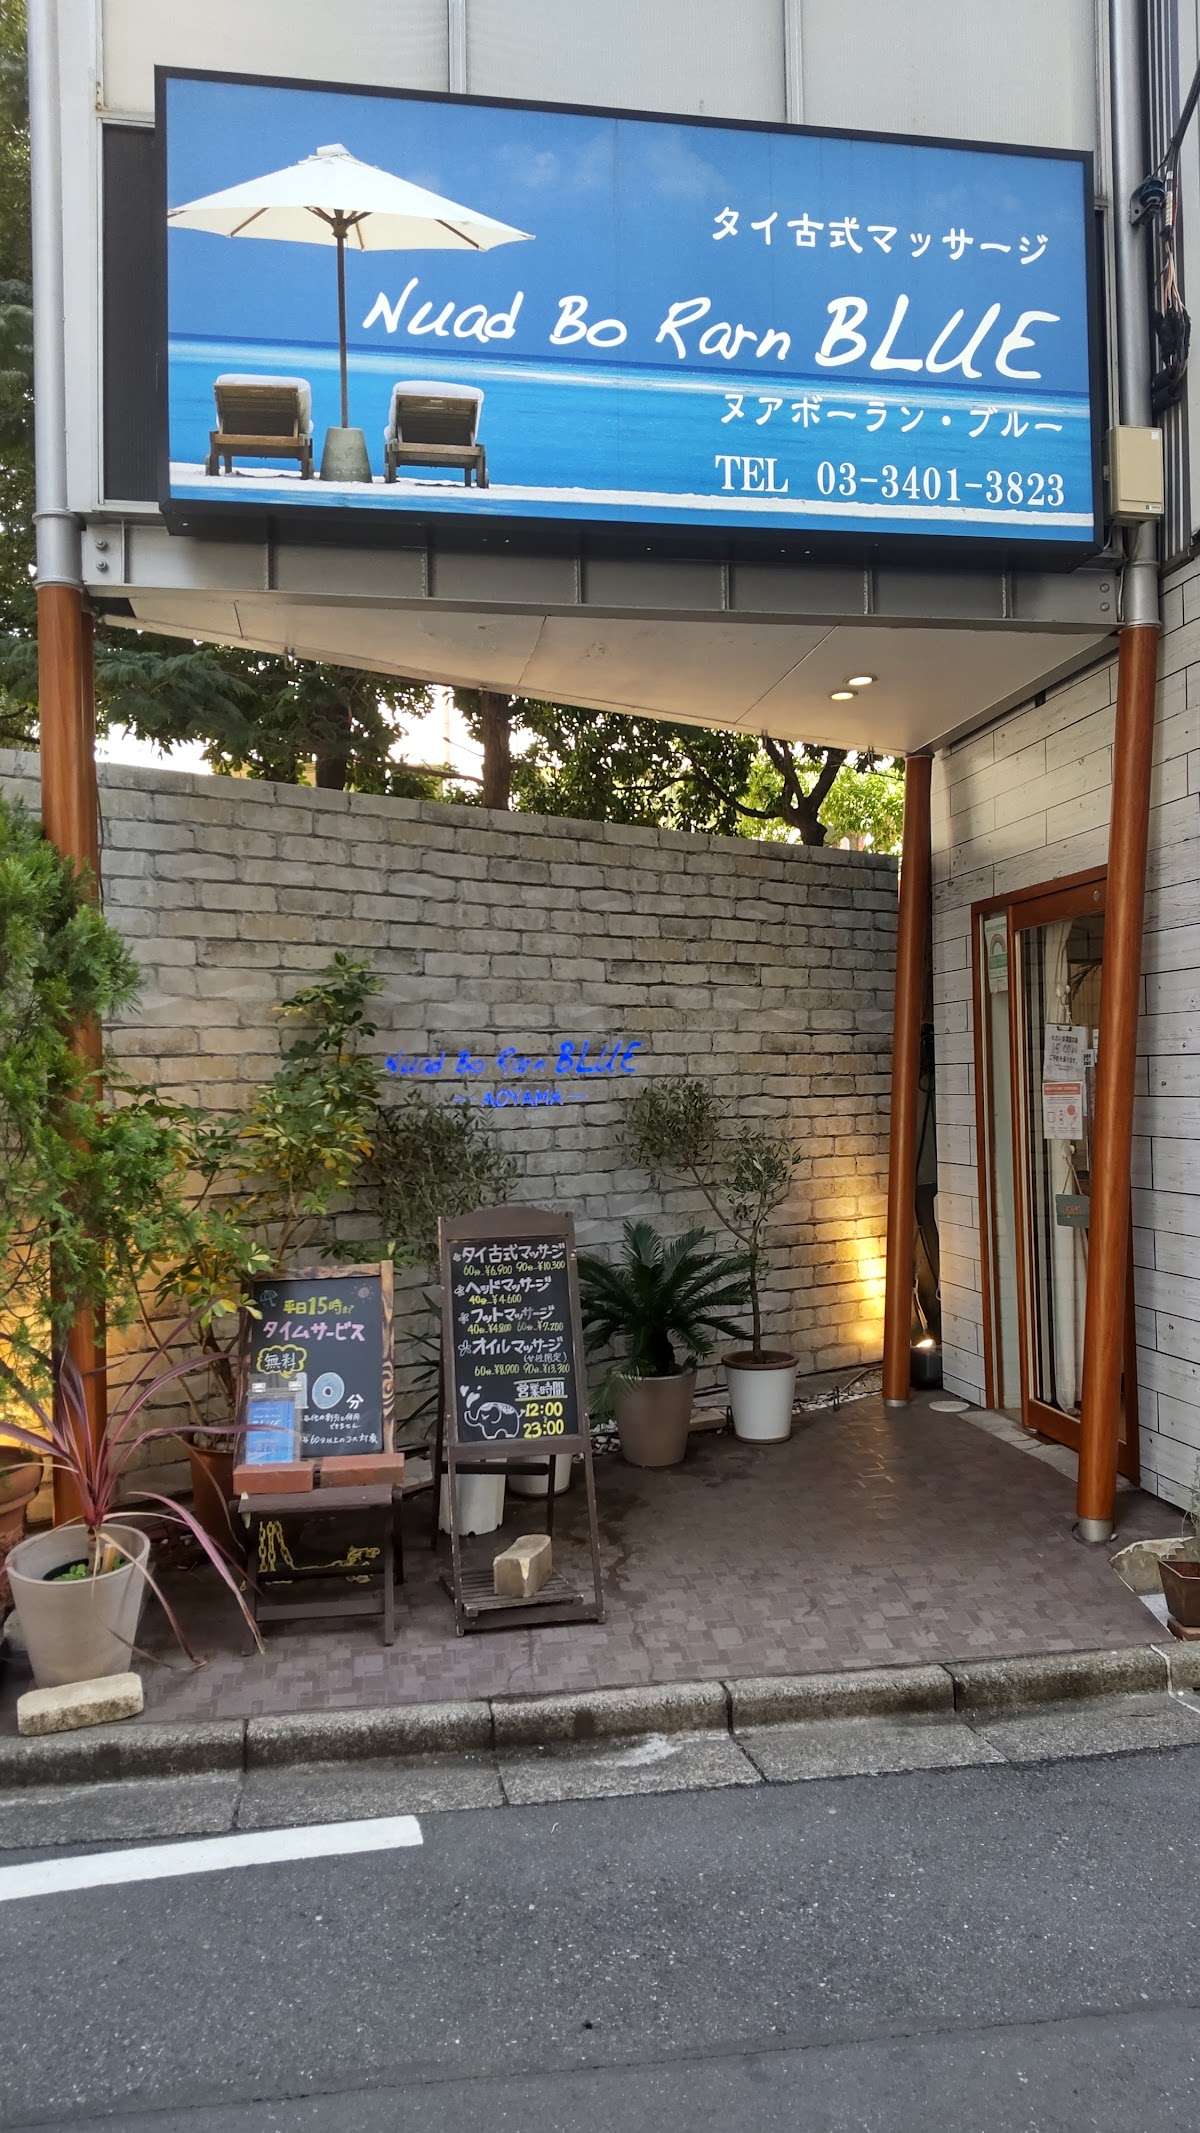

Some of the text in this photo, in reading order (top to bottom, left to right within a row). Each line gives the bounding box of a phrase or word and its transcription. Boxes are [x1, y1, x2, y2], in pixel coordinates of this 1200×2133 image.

[712, 206, 1049, 265] タイ古式マッサージ
[362, 277, 1061, 379] Nuad Bo Rarn BLUE
[720, 393, 1063, 438] ヌアボーラン・ブルー
[715, 455, 1065, 507] TEL 03-3401-3823
[456, 1050, 486, 1075] Bo
[555, 1040, 643, 1075] BLUE
[481, 1089, 564, 1108] AOYAMA
[461, 1243, 566, 1264] タイ古式マッサージ
[465, 1276, 552, 1295] ヘッドマッサージ
[470, 1305, 555, 1323] フットマッサージ
[262, 1321, 366, 1342] タイムサービス
[472, 1336, 564, 1356] オイルマッサージ
[264, 1352, 296, 1370] 無料
[516, 1382, 565, 1398] 営業時間
[524, 1401, 564, 1418] 12:00
[523, 1418, 565, 1439] 23:00
